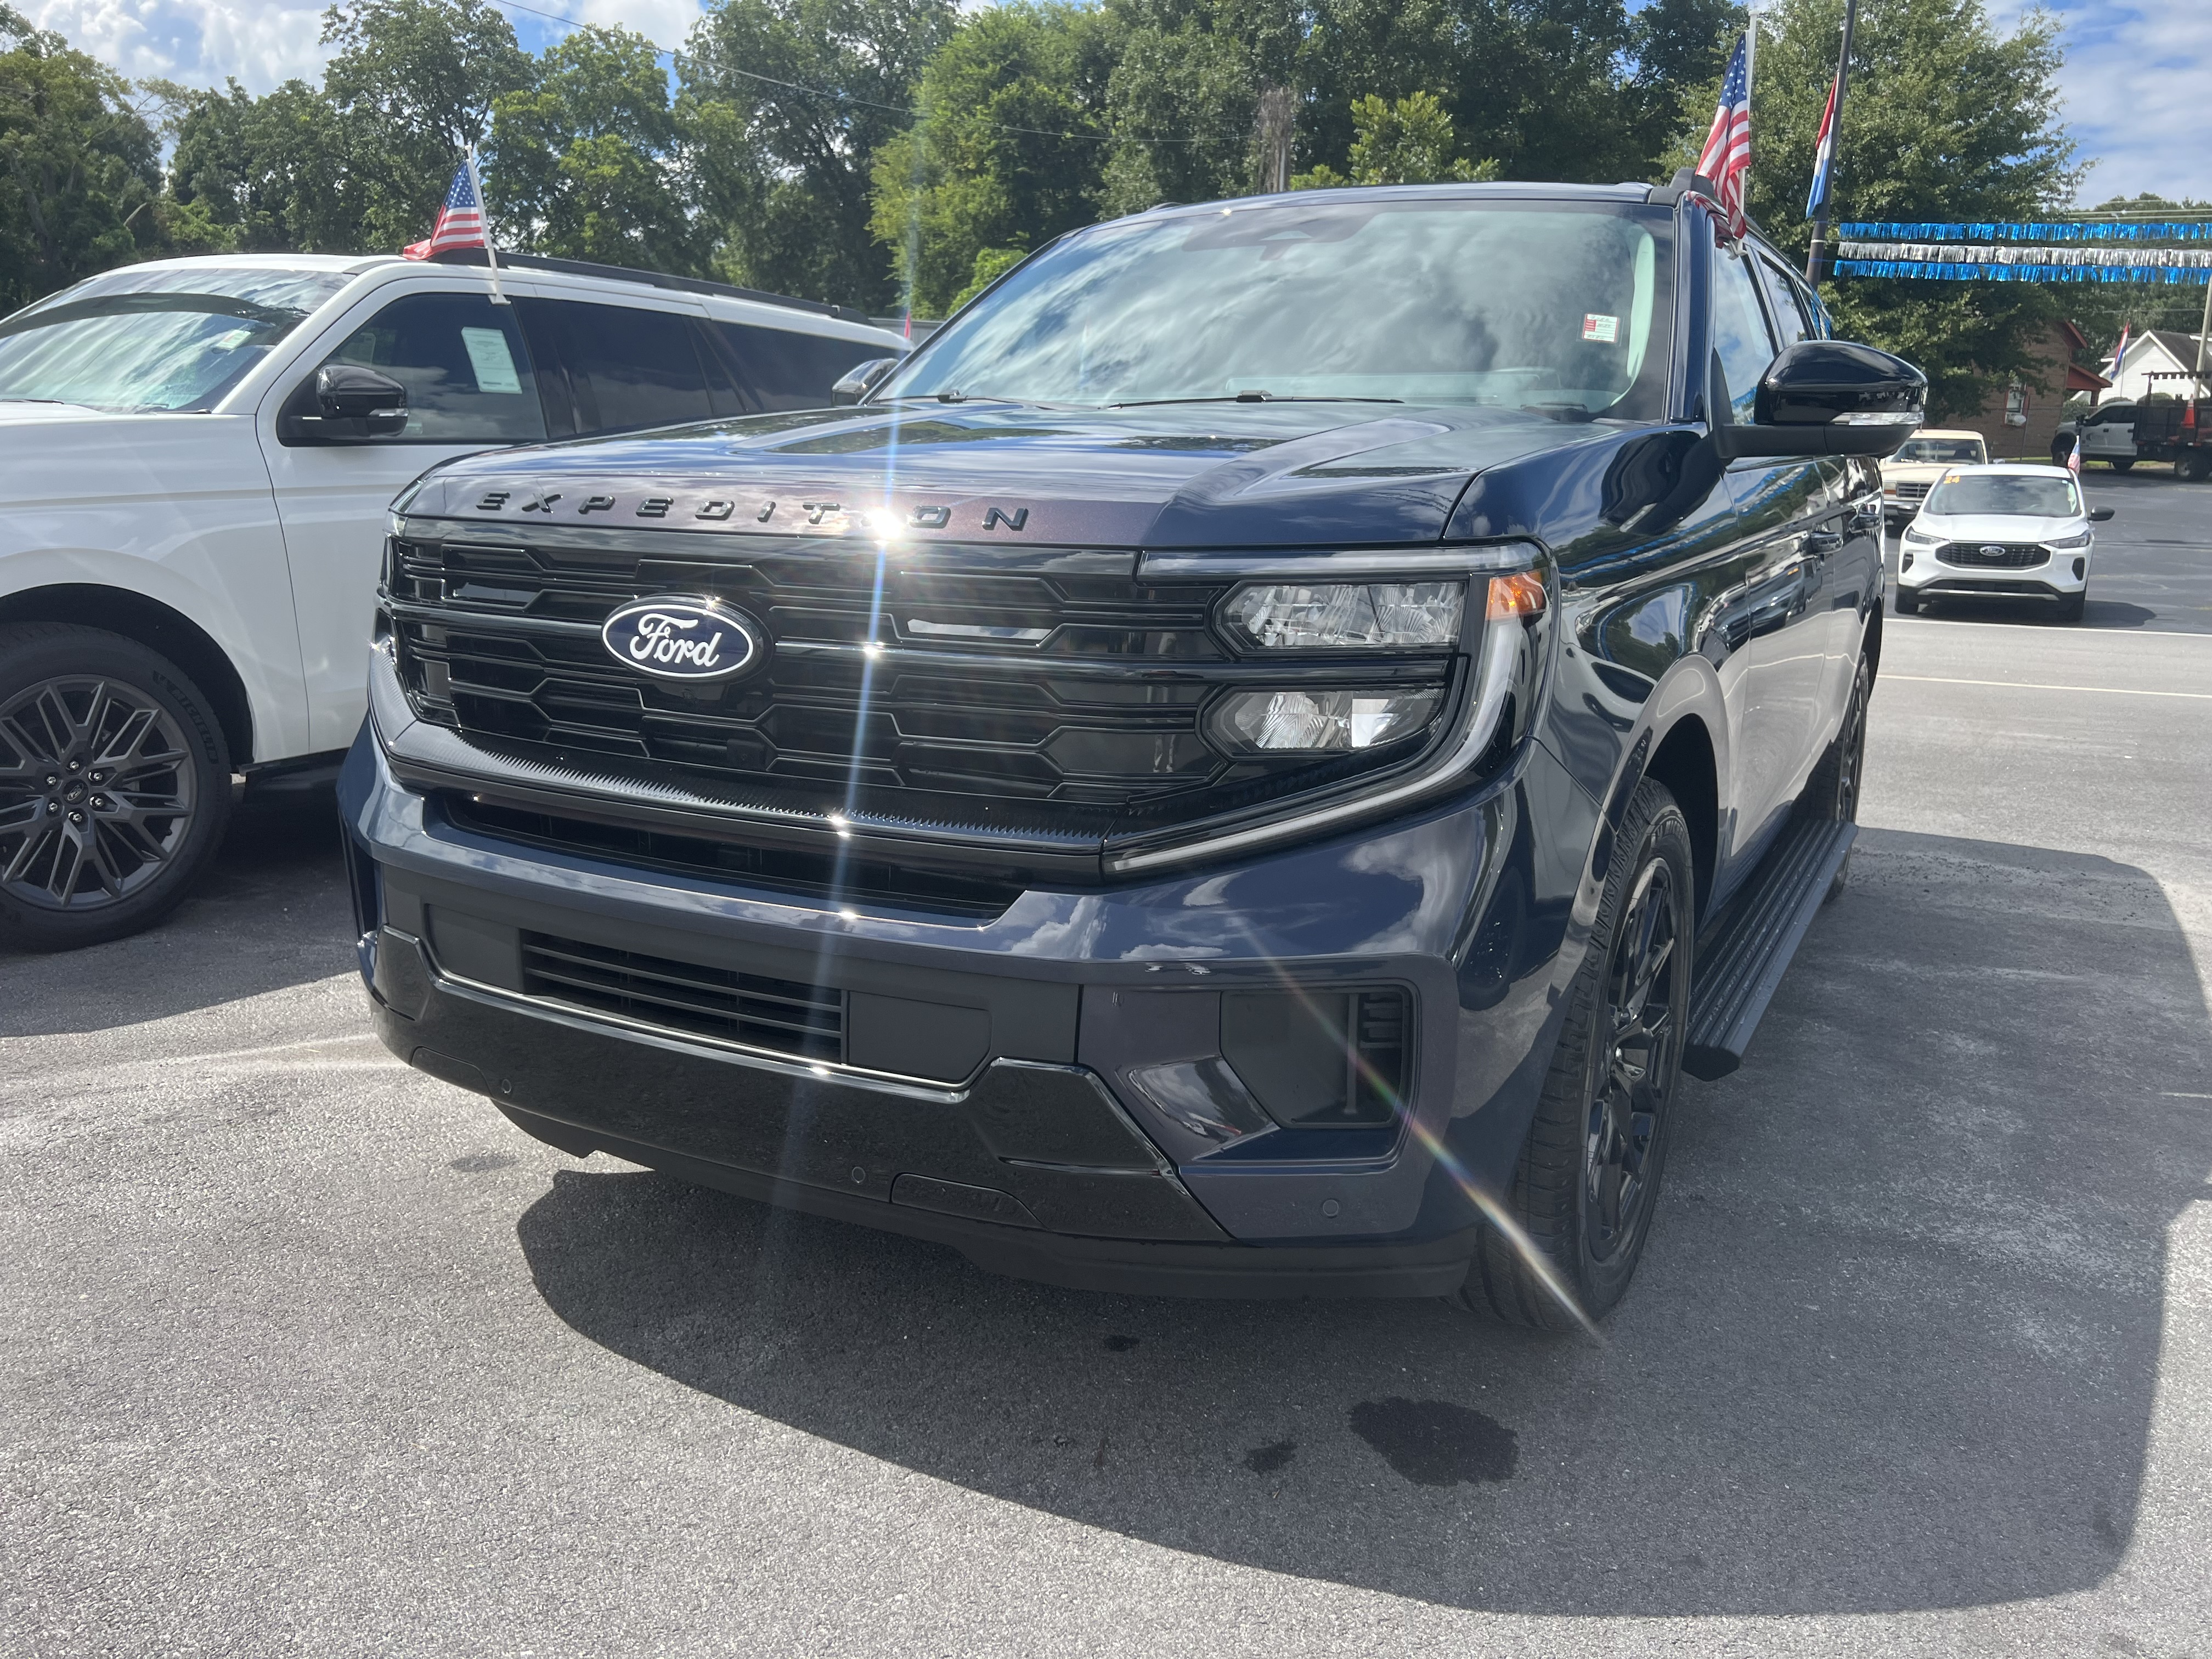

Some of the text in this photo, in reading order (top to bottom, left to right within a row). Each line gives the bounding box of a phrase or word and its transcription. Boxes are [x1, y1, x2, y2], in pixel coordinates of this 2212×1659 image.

[1943, 475, 1960, 484] 24
[475, 491, 1030, 531] EXPEDITON
[630, 613, 722, 667] Ford
[170, 685, 219, 764] MICHELIN
